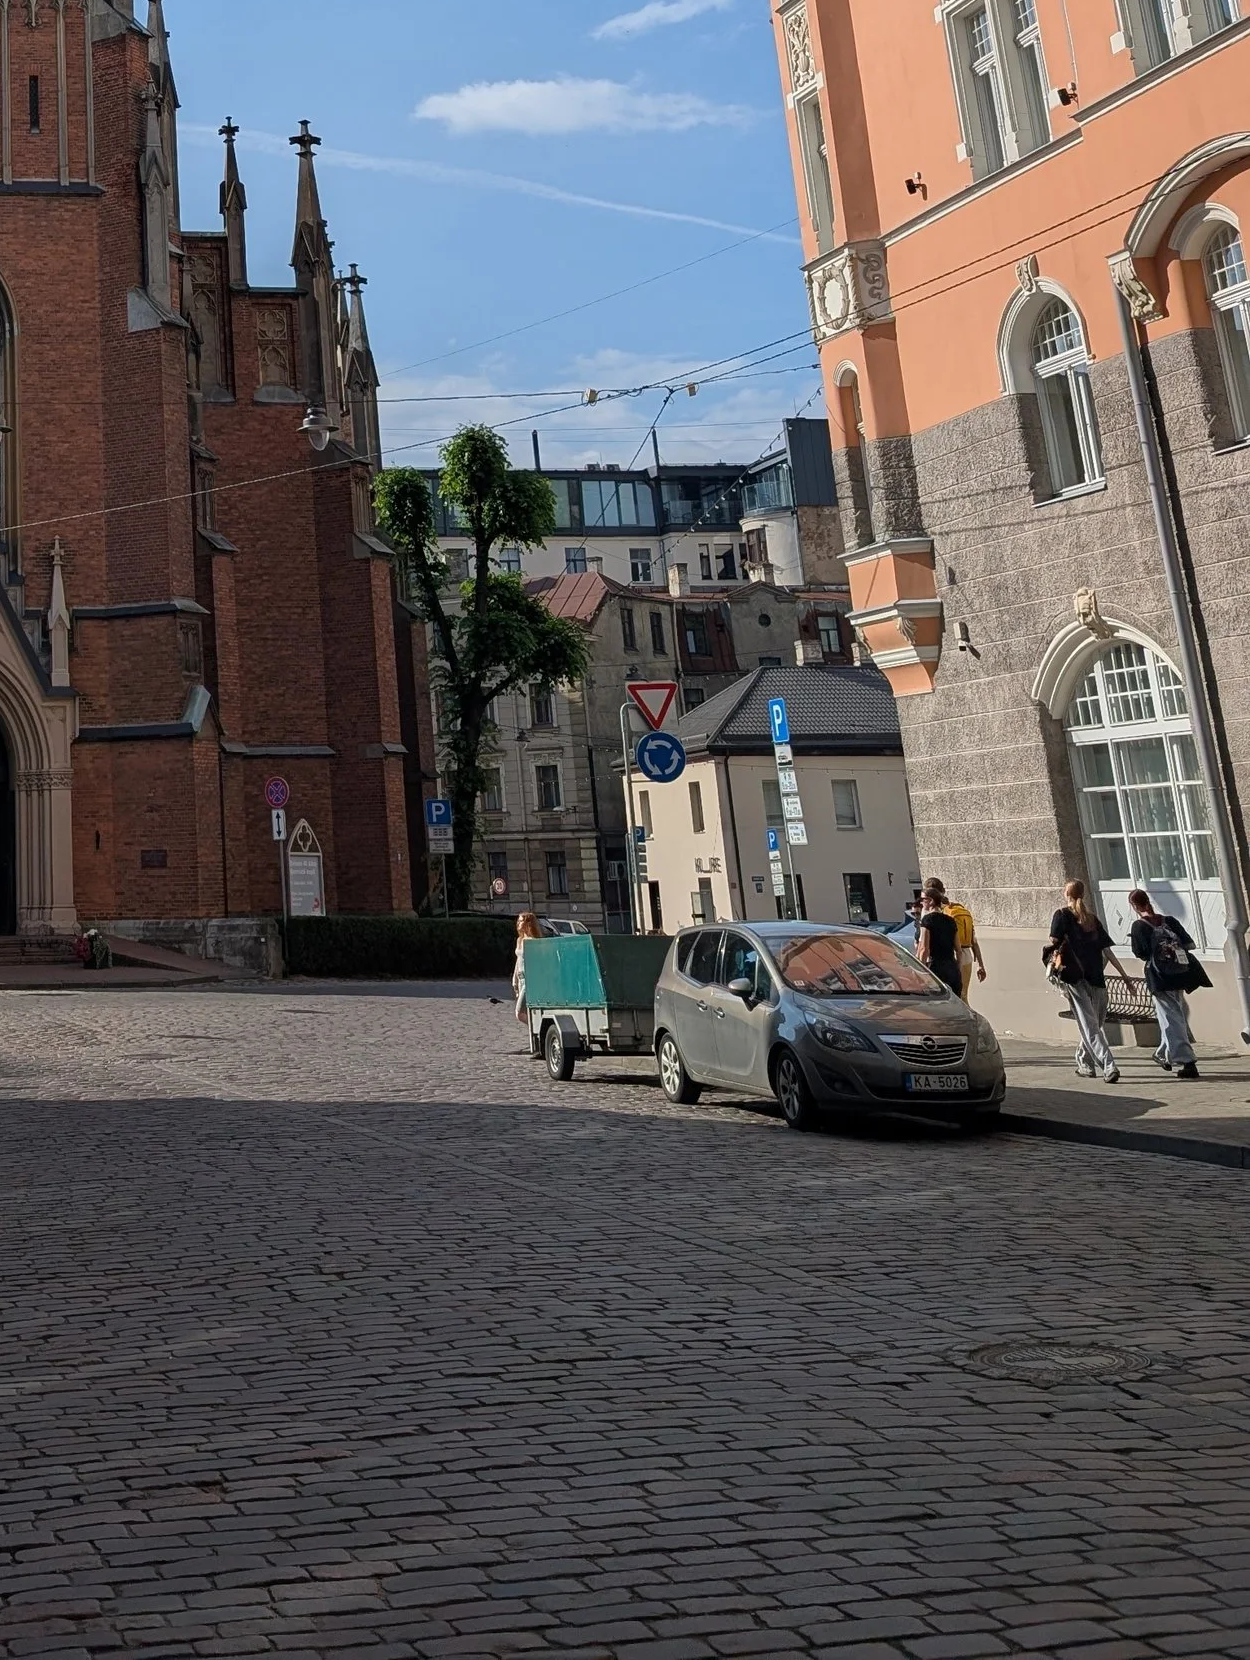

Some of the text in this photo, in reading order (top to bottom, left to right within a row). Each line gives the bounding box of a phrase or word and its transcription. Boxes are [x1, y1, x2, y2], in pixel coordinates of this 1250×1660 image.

[773, 705, 782, 736] P
[432, 803, 445, 822] P
[769, 832, 775, 848] P
[914, 1076, 967, 1088] KA-5026
